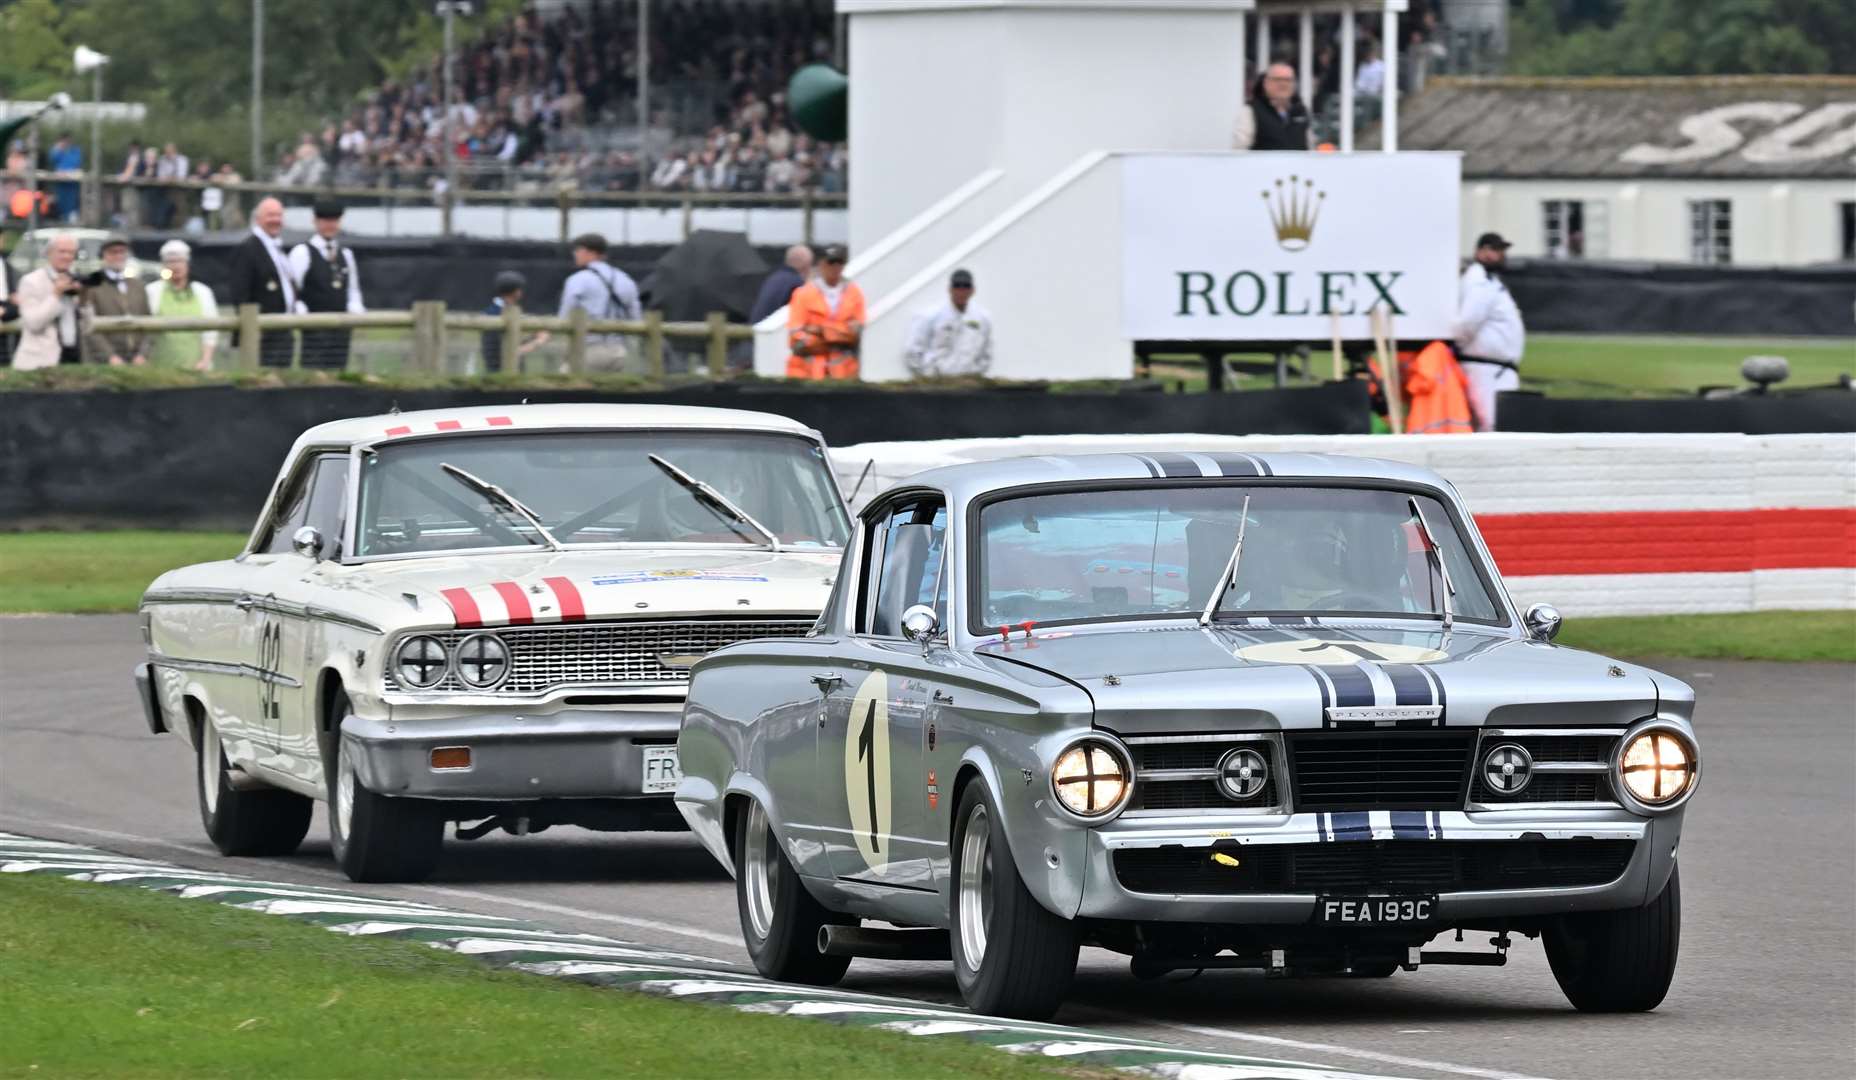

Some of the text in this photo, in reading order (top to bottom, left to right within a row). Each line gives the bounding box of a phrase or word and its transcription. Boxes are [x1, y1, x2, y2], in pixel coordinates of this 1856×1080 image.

[1619, 101, 1856, 163] SU
[1174, 269, 1406, 317] ROLEX
[1297, 642, 1389, 662] 1
[261, 620, 280, 720] 92
[1335, 709, 1436, 719] PLYMOUTH
[646, 758, 676, 780] FR
[858, 698, 880, 854] 1
[1324, 900, 1430, 922] FEA 193C
